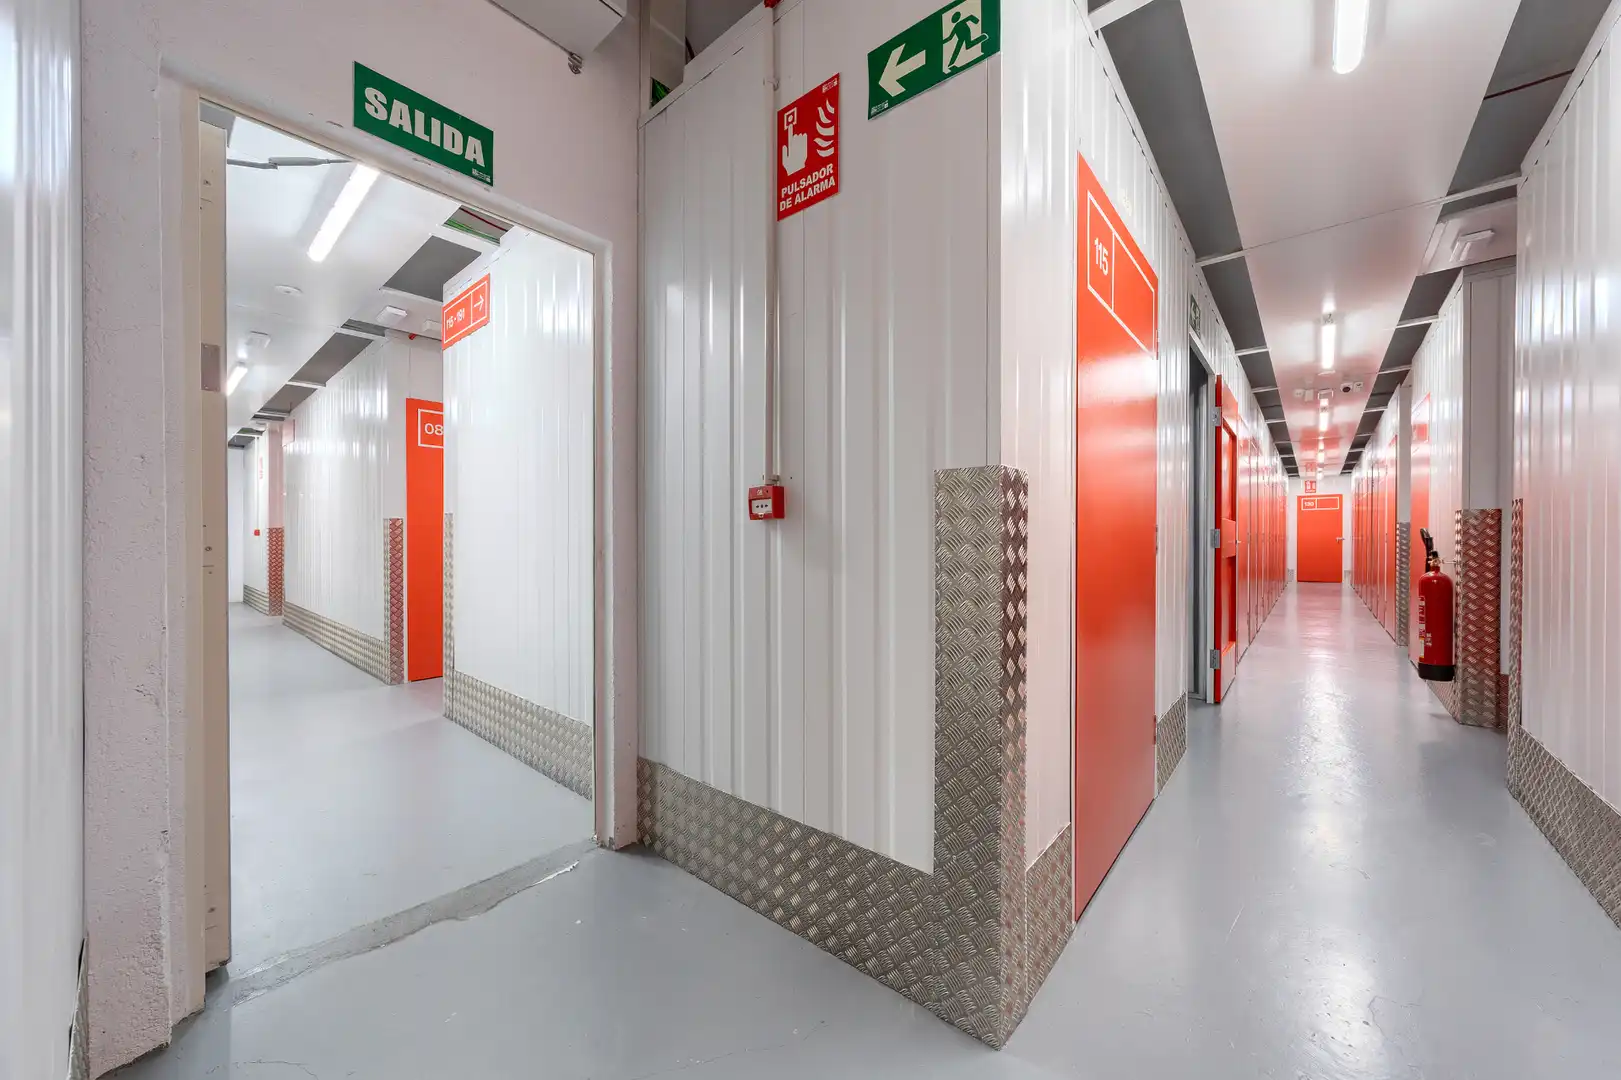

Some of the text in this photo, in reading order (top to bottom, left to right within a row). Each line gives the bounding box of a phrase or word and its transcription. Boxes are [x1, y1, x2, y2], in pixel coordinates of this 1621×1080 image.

[364, 87, 485, 167] SALIDA
[779, 176, 835, 211] DE ALARMA
[781, 163, 833, 198] PULSADOR
[1094, 237, 1108, 276] 115
